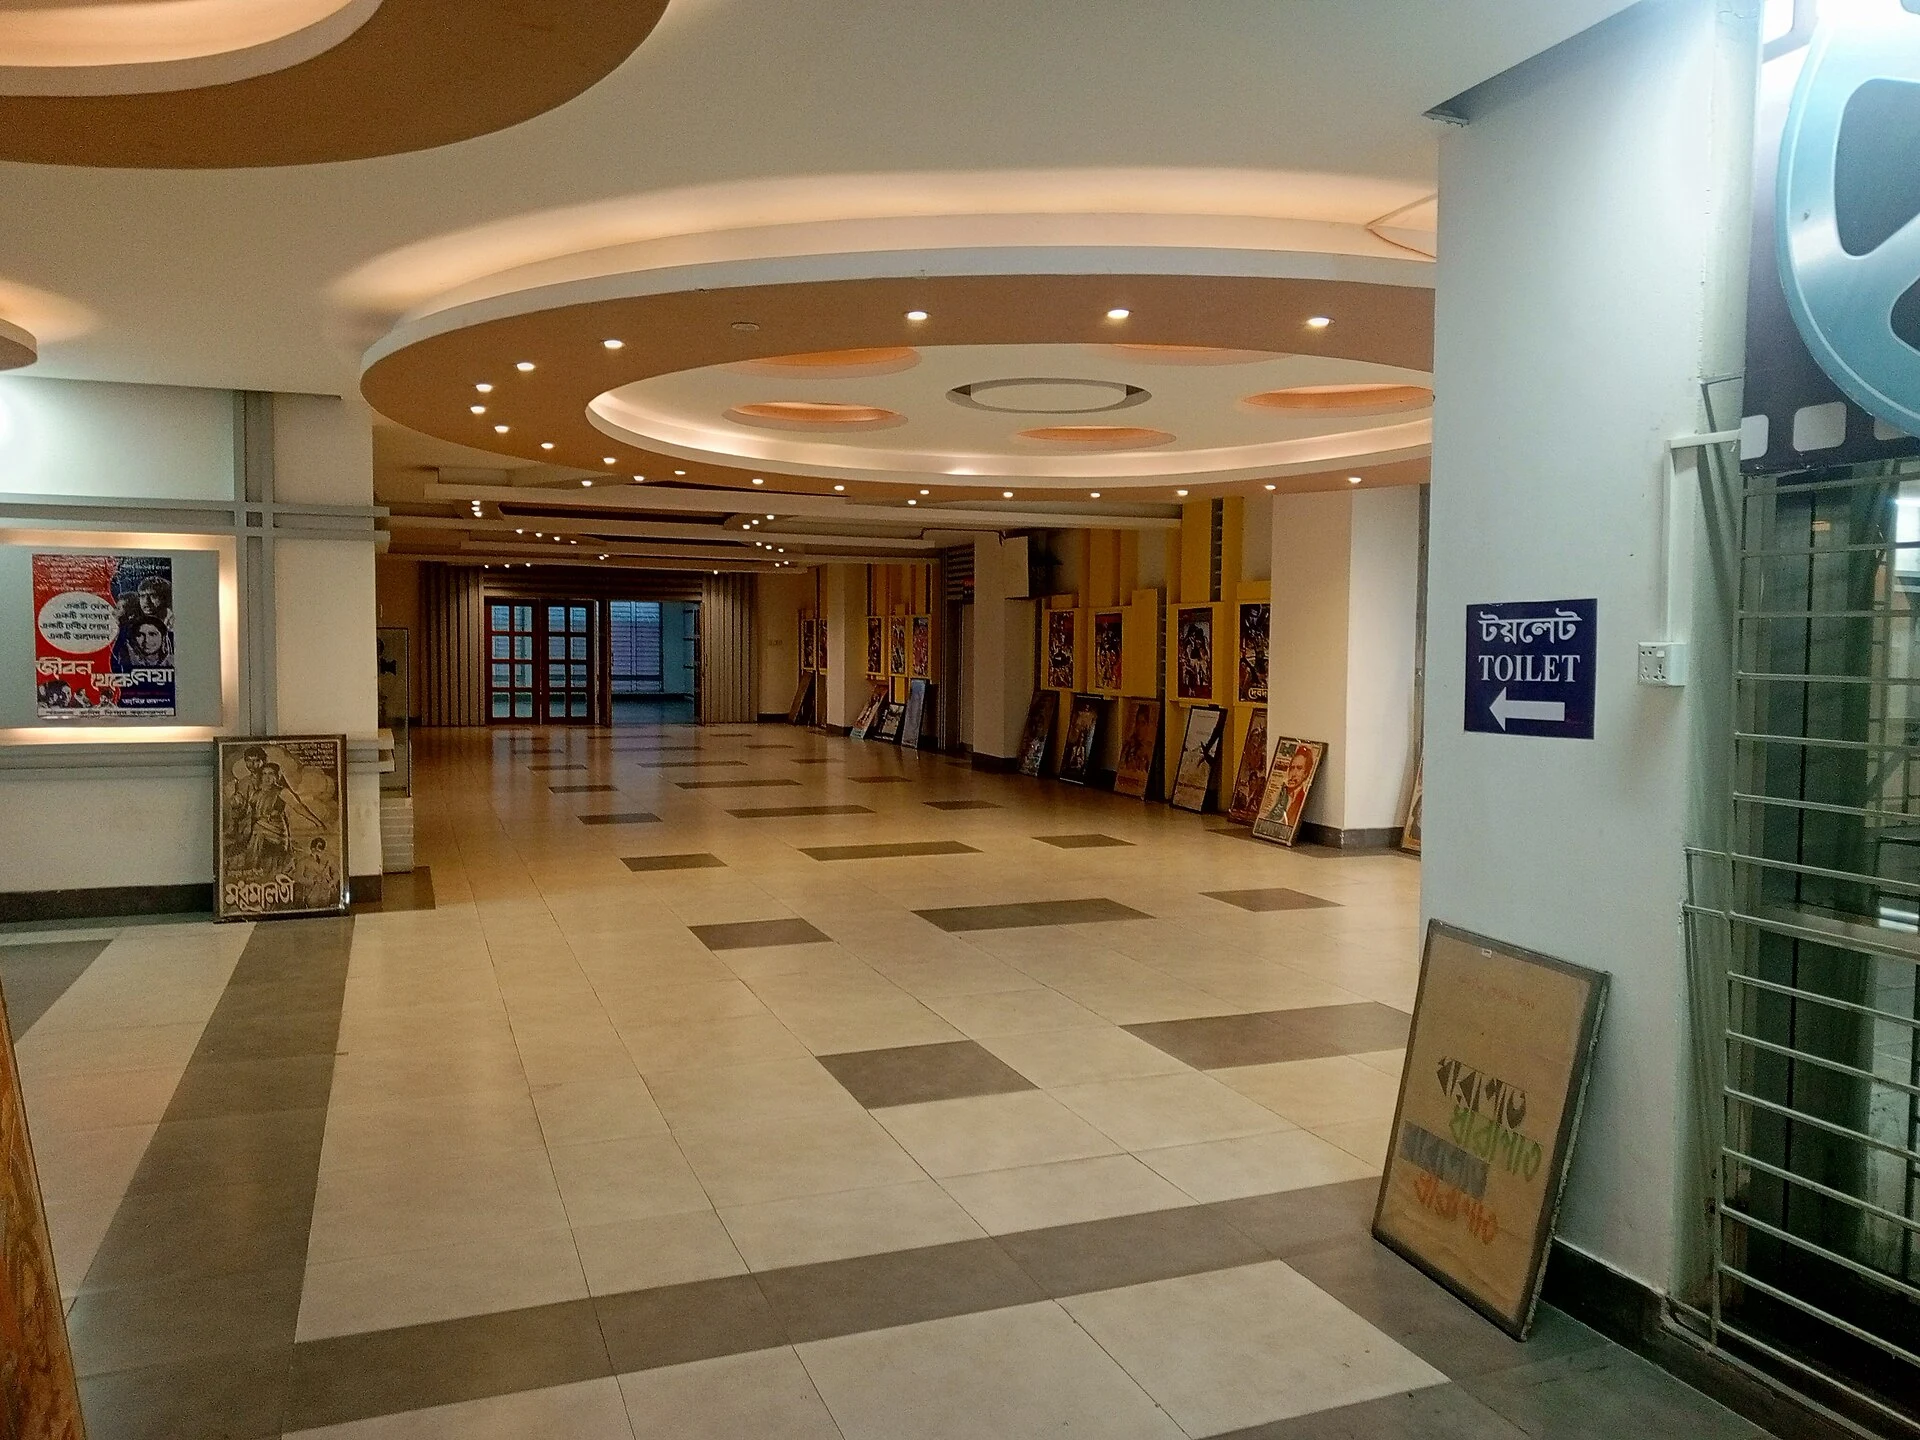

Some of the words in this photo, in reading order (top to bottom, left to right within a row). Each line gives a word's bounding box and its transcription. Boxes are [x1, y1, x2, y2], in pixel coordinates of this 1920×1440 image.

[1478, 608, 1583, 645] টয়লেট
[35, 656, 95, 680] জীবন
[91, 672, 133, 691] থেকে
[130, 668, 175, 685] নেয়া
[1478, 654, 1581, 682] TOILET
[1248, 687, 1269, 700] দেবদ
[225, 873, 295, 912] মধুমালতী
[1437, 1056, 1528, 1129] ধারাপাত
[1449, 1104, 1544, 1183] ধারাপাত
